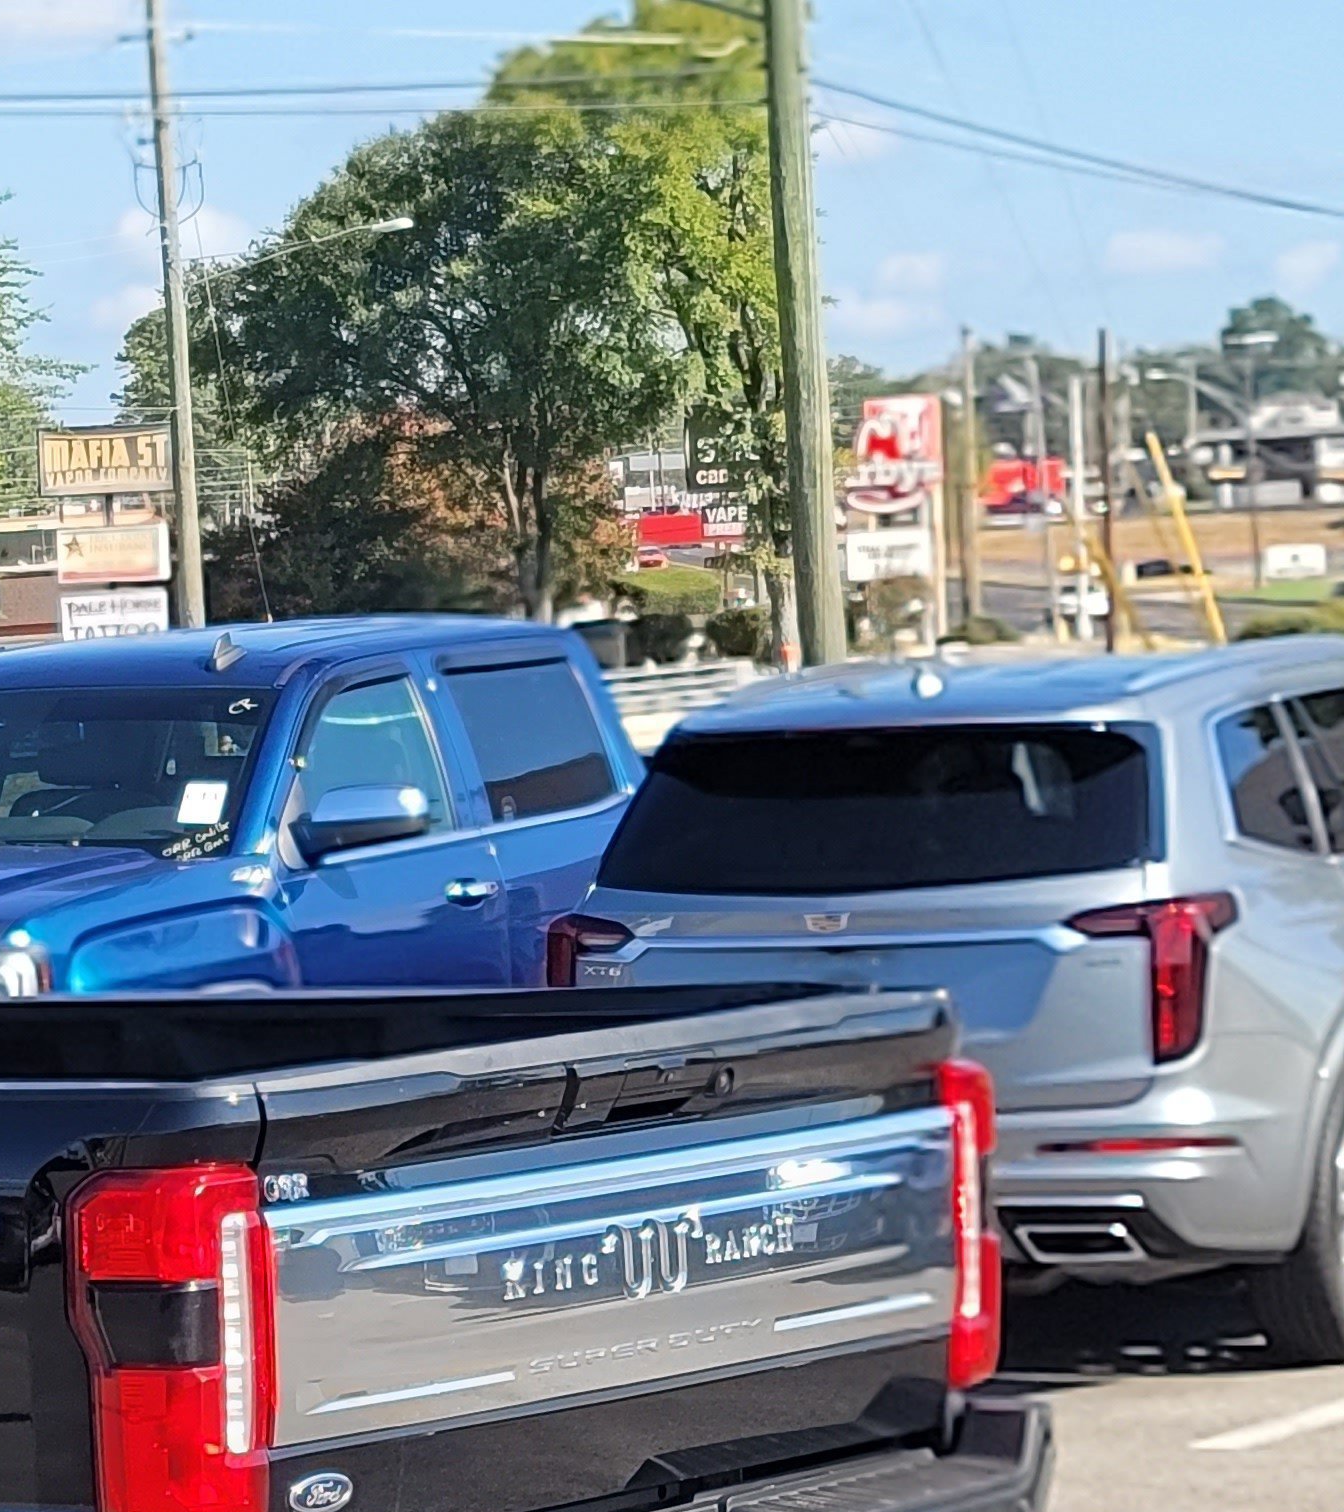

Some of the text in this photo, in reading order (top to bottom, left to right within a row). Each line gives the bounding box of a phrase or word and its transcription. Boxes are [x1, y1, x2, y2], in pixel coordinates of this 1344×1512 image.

[43, 433, 168, 472] MAFIA ST
[695, 469, 729, 485] CBD
[706, 505, 748, 523] VAPE
[501, 1214, 795, 1301] KING RANCH
[527, 1317, 762, 1375] SUPER DUTY
[306, 1480, 342, 1507] Ford
